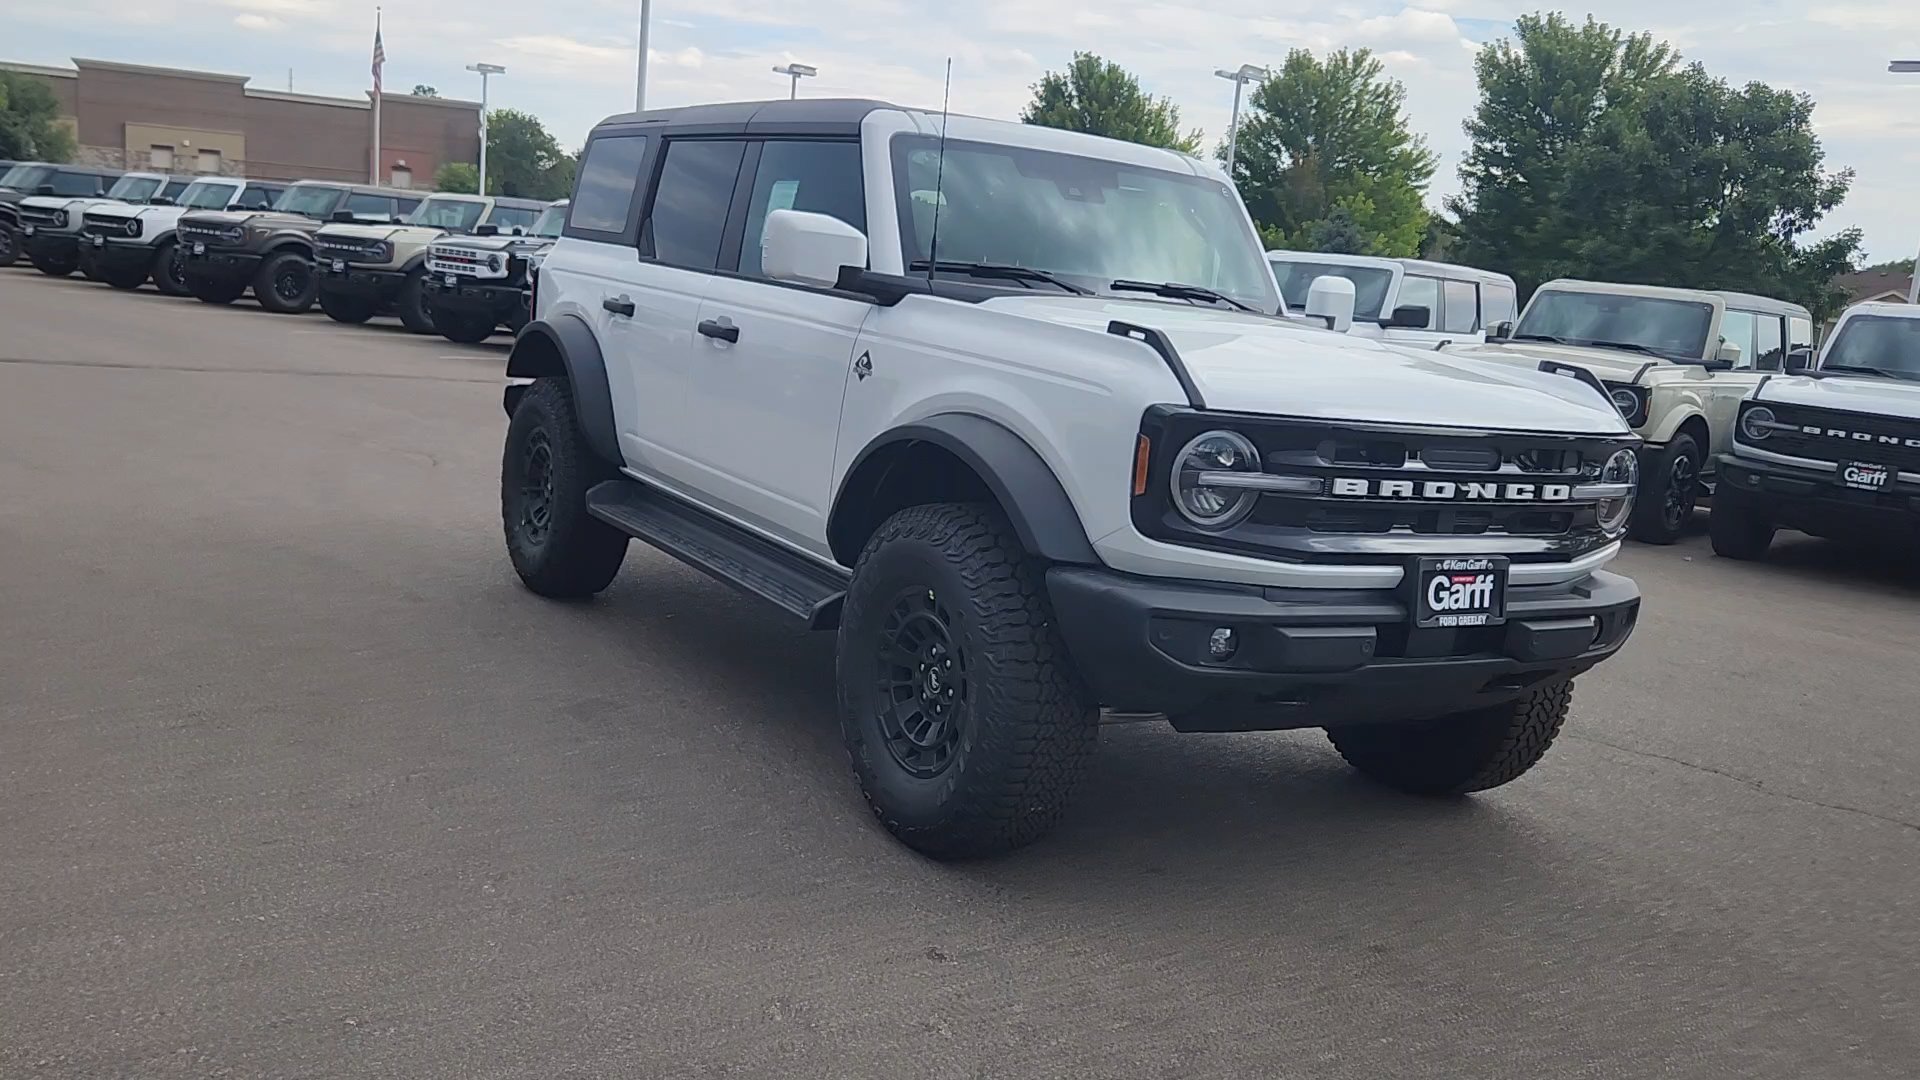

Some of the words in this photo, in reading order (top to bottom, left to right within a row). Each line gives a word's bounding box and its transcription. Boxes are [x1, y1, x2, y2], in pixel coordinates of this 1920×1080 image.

[1844, 467, 1888, 486] Garff
[1332, 478, 1570, 500] BRONCO
[1450, 559, 1467, 570] Ken
[1467, 559, 1488, 570] Garff
[1428, 574, 1494, 611] Garff
[1439, 616, 1457, 627] FORD
[1458, 615, 1487, 626] GREELEY
